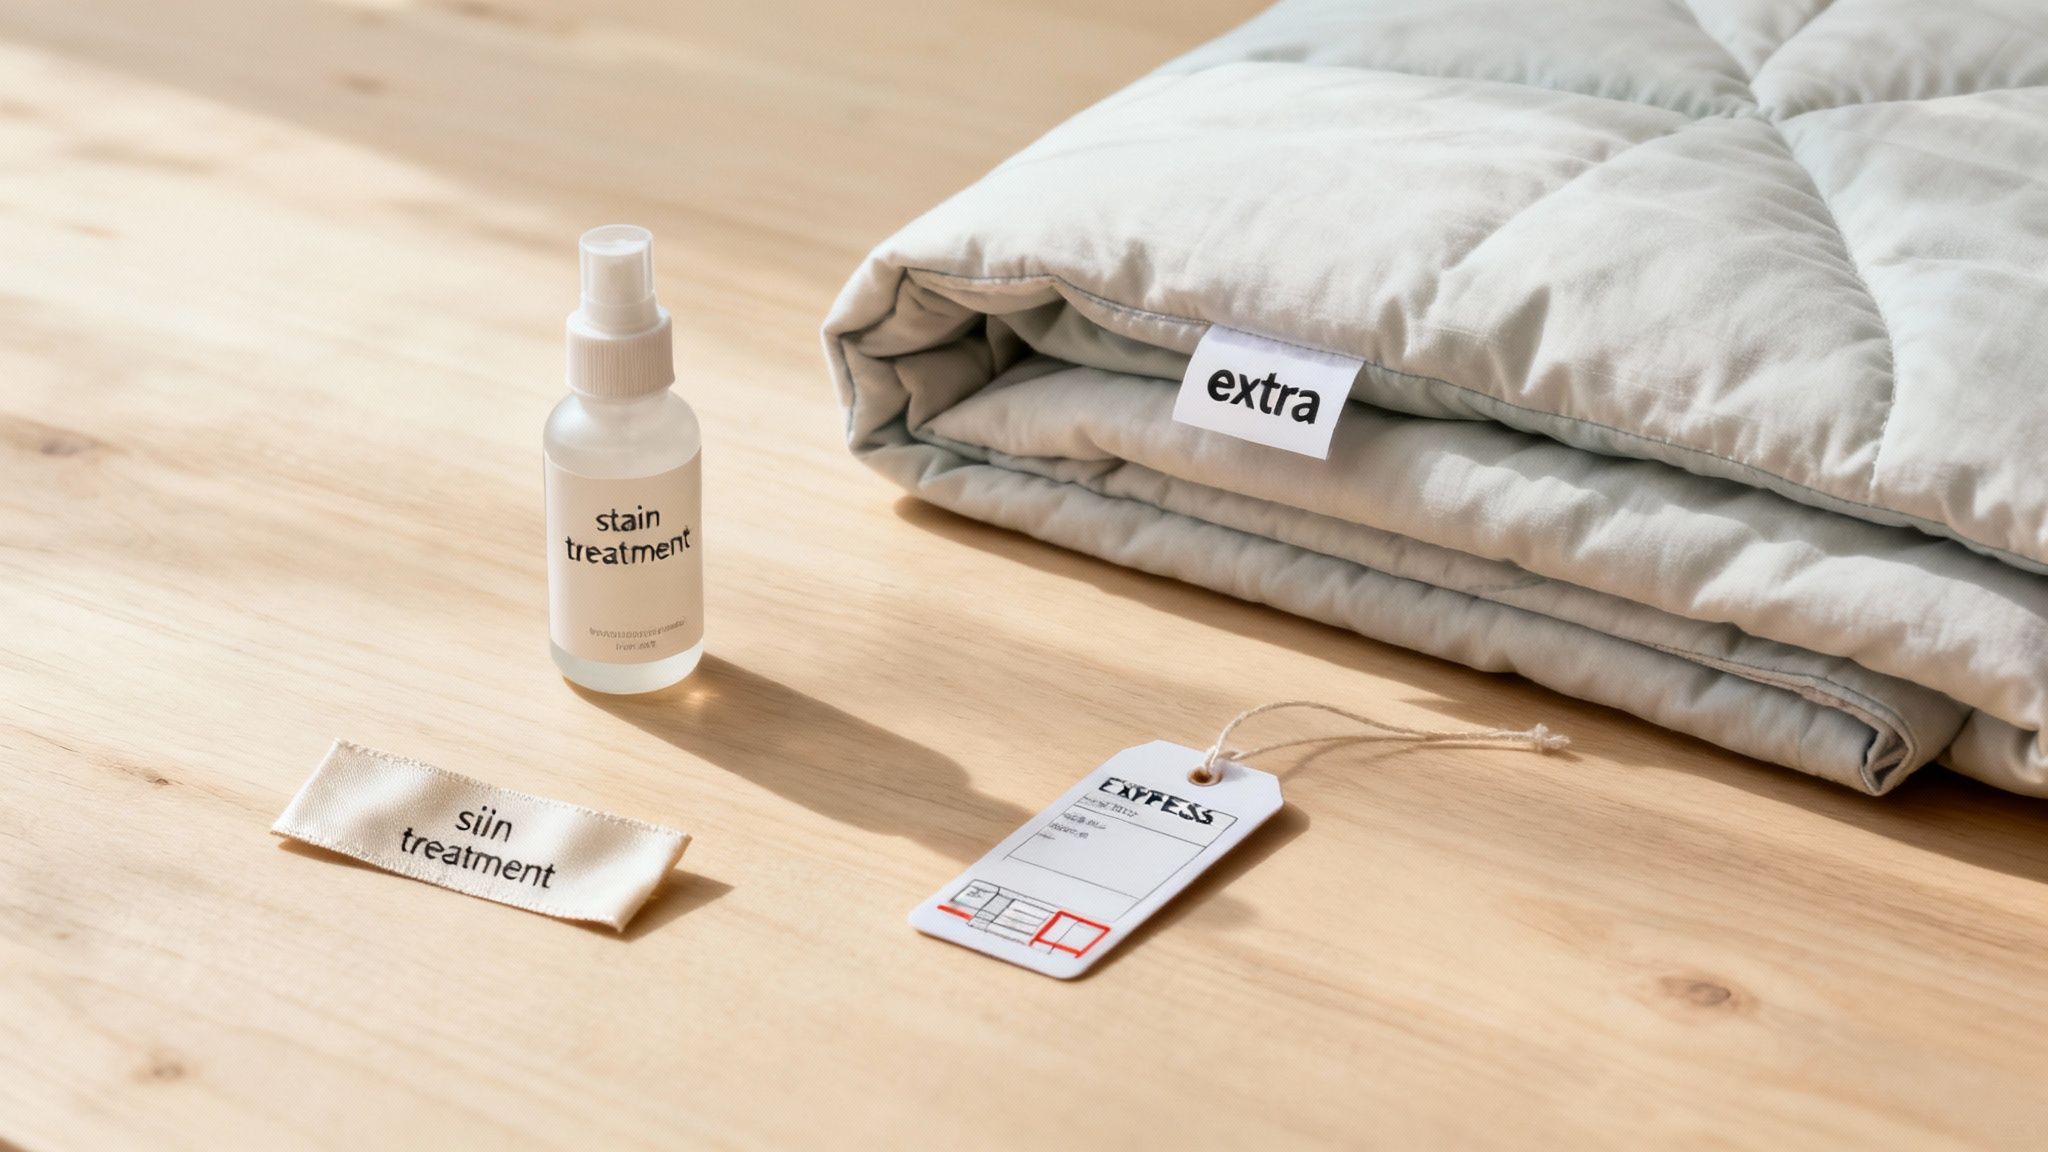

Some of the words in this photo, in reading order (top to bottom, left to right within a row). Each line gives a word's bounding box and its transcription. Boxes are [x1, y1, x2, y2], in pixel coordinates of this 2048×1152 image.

[1207, 369, 1321, 425] extra
[596, 505, 660, 532] stain
[565, 527, 691, 565] treatment
[455, 807, 513, 842] siin
[401, 828, 557, 888] treatment
